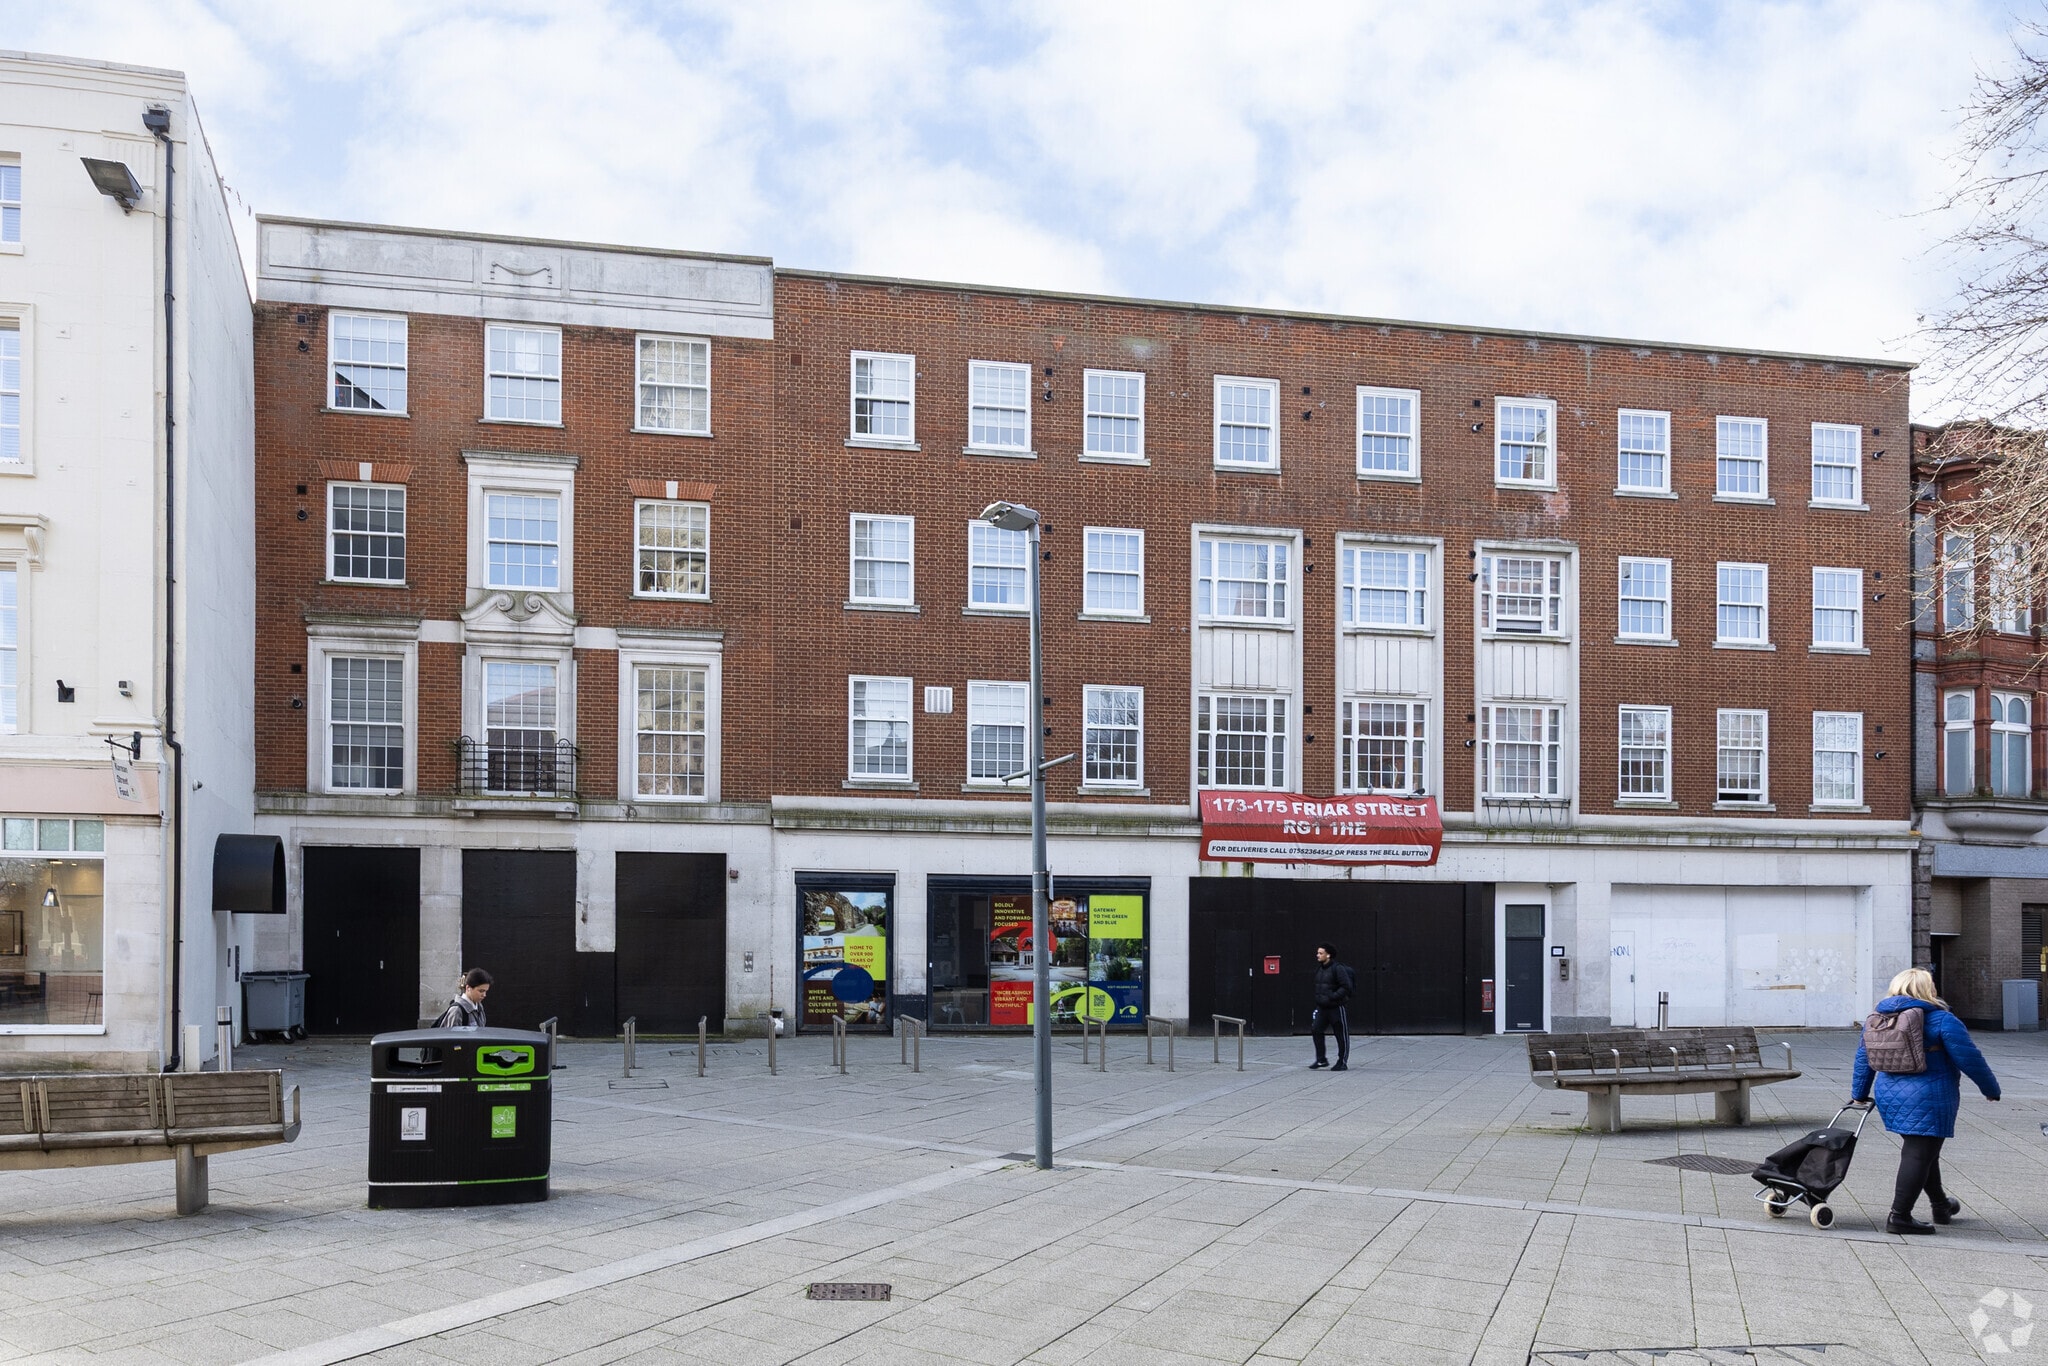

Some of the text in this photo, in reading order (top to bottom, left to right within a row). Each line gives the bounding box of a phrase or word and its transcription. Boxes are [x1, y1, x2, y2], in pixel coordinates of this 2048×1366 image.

[1213, 798, 1428, 817] 173-175 FRIAR STREET
[1283, 819, 1321, 835] RG1
[1401, 849, 1429, 857] BUTTON
